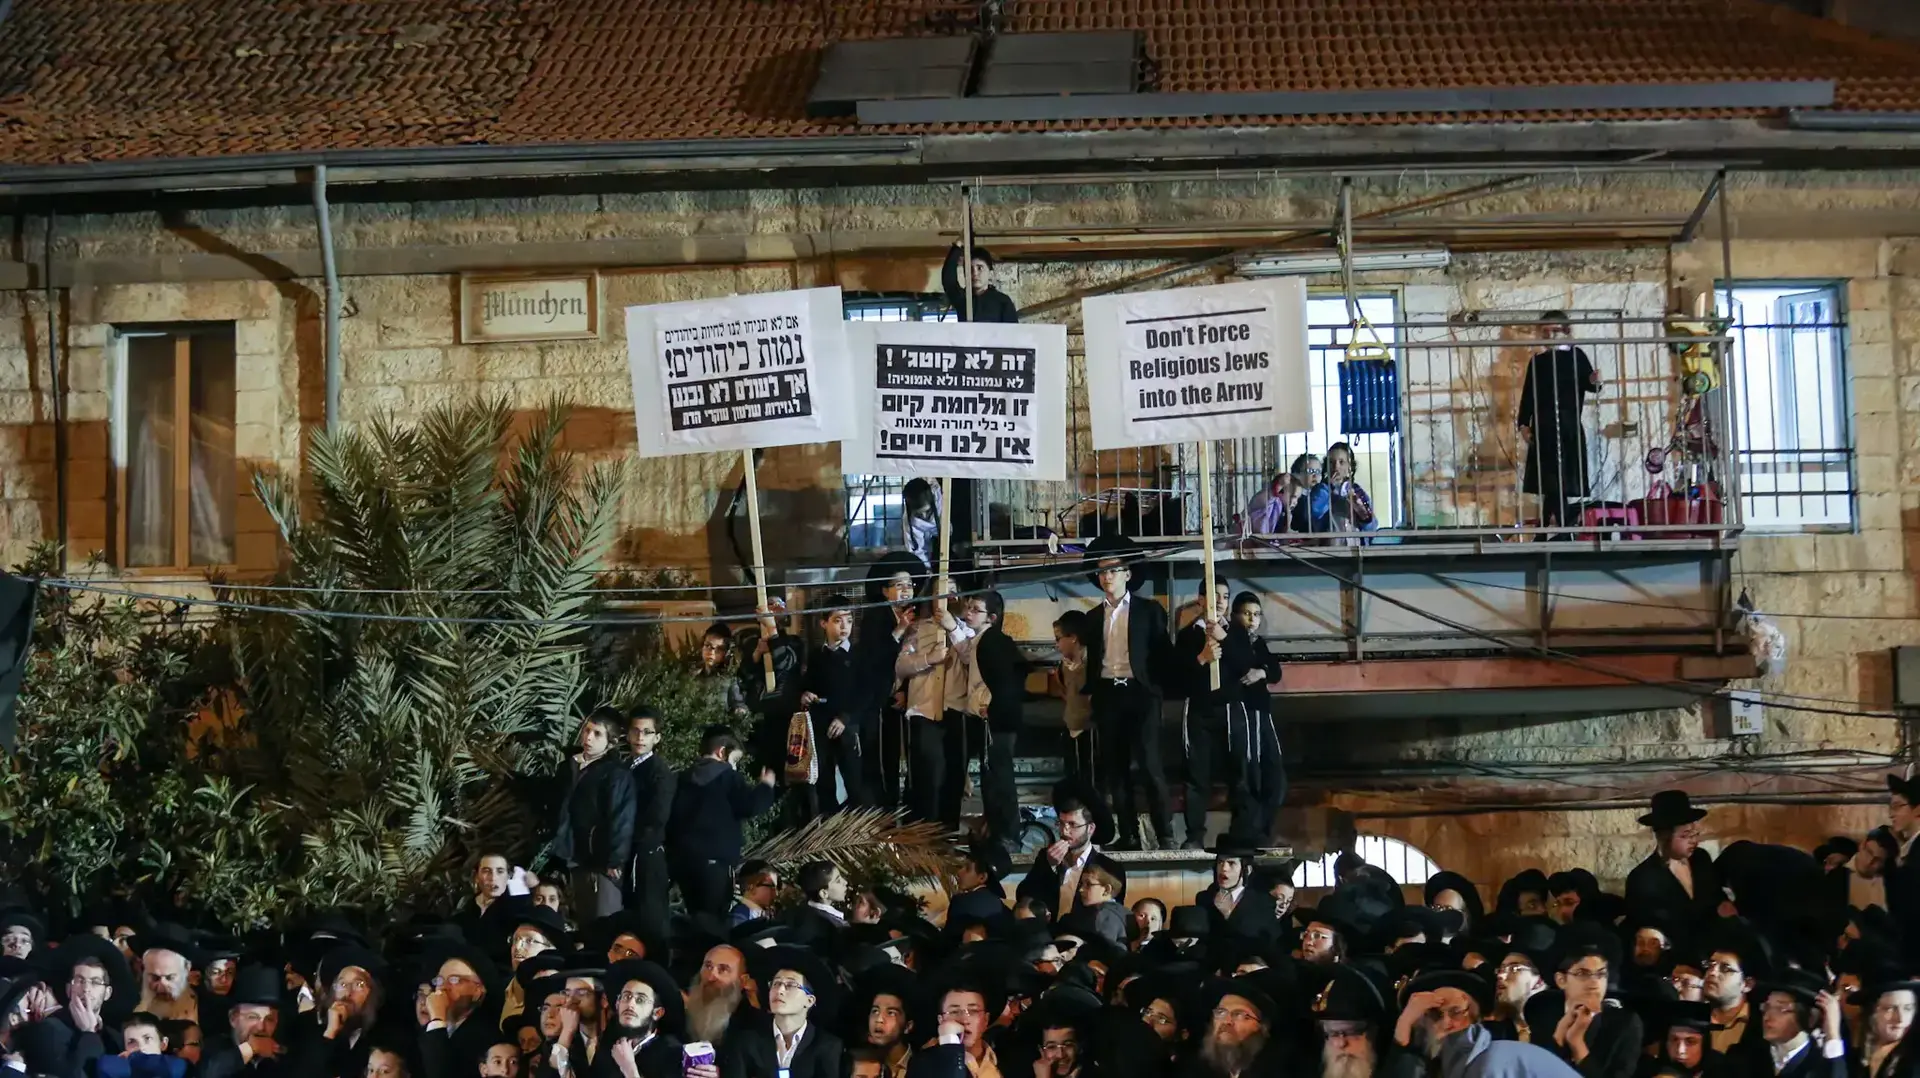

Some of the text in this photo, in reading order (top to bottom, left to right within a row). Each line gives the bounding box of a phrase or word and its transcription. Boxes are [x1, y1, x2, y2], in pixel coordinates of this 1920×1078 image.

[665, 315, 799, 343] אם לא תניחו לנו לחיות כיהודים
[1145, 323, 1250, 349] Don't Force
[665, 334, 805, 378] נמות כיהודים!
[901, 349, 957, 373] קוטג'
[964, 350, 994, 370] לא
[1001, 354, 1027, 371] זה
[1129, 351, 1269, 380] Religious Jews
[671, 373, 807, 408] אך לעולם לא נכנע
[887, 372, 1025, 389] לא עמונה! ולא אמוניה!
[881, 393, 1029, 417] זו מלחמת קיום
[1139, 382, 1264, 409] into the Army
[895, 417, 1016, 432] כי בלי תורה ומצוות
[880, 429, 1031, 459] אין לנו חיים!
